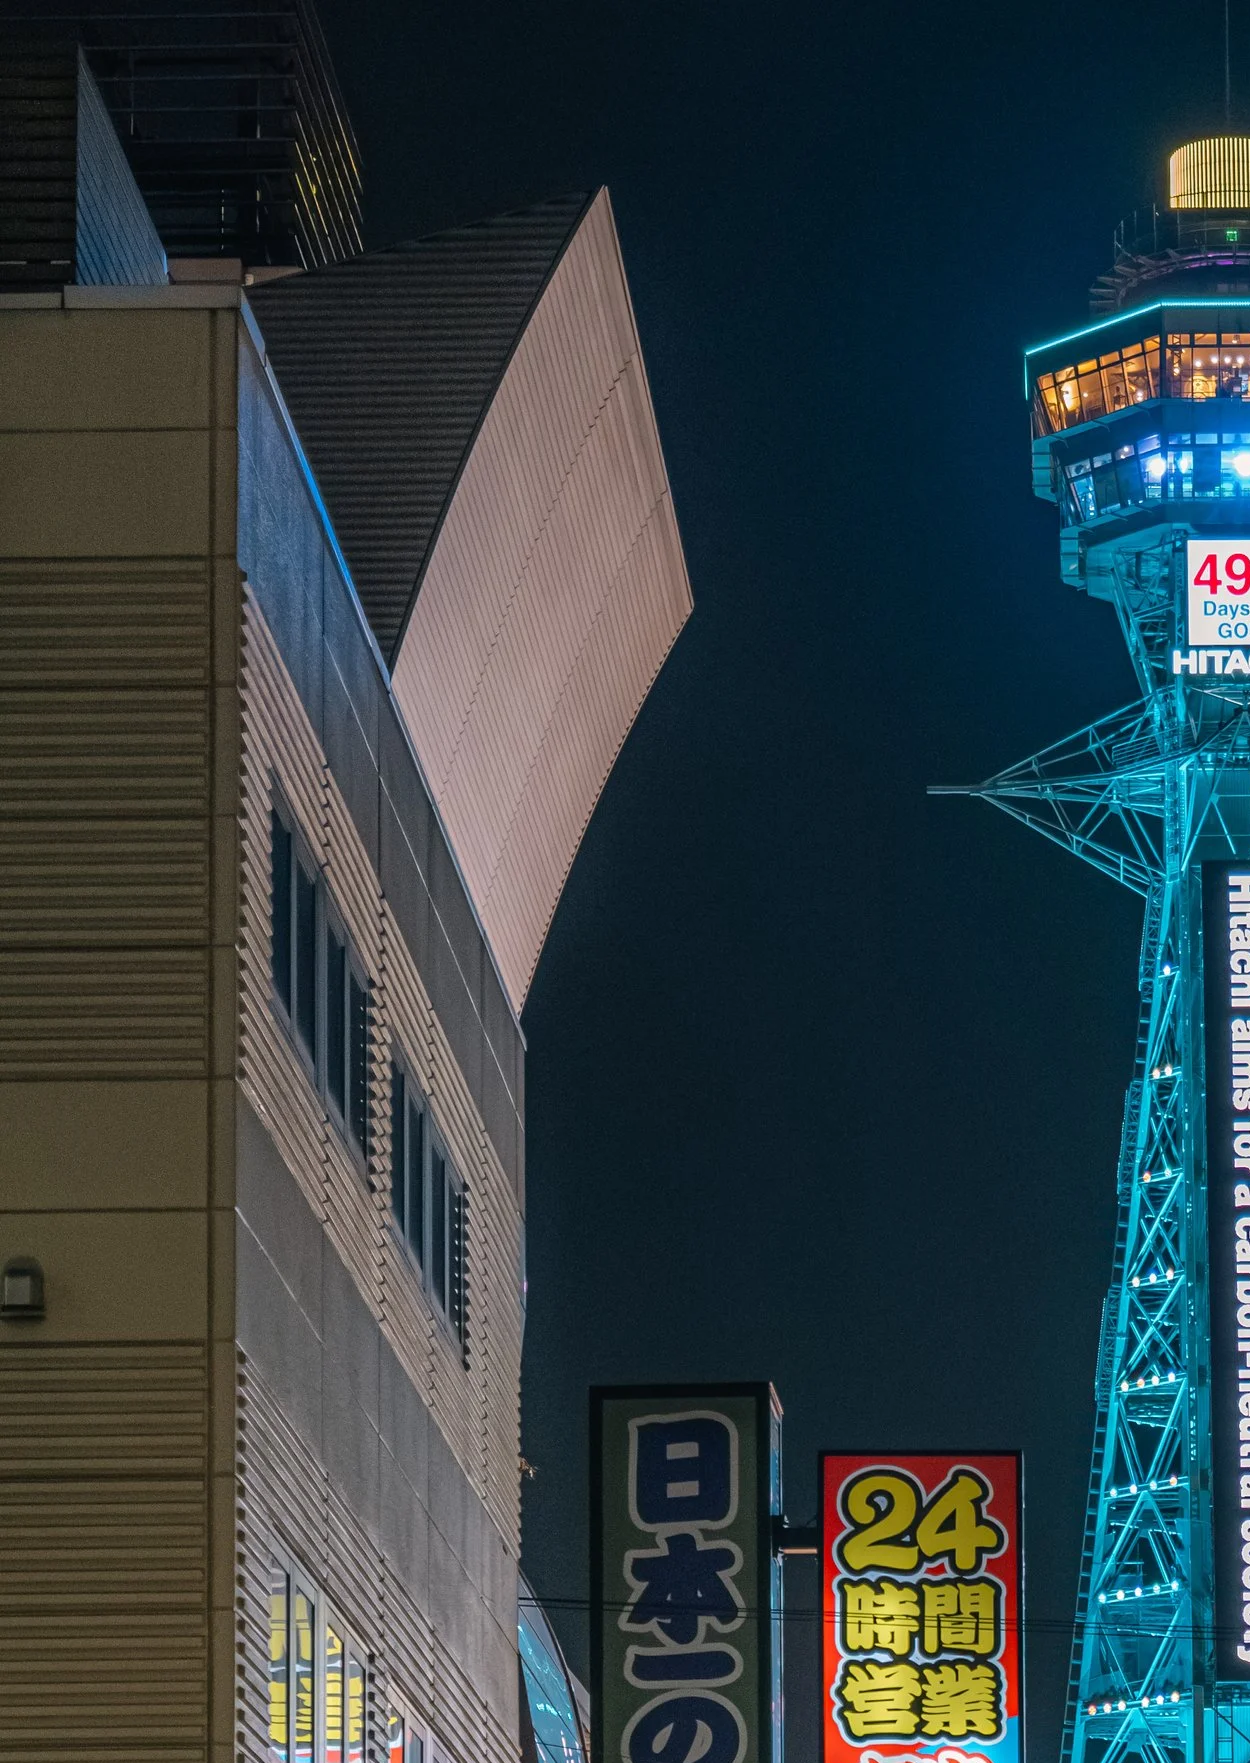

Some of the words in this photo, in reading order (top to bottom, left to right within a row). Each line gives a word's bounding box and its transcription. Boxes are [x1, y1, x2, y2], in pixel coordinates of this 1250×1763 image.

[1203, 600, 1250, 619] Days
[838, 1469, 1003, 1576] 24
[840, 1580, 999, 1658] 時間
[840, 1662, 999, 1738] 営業
